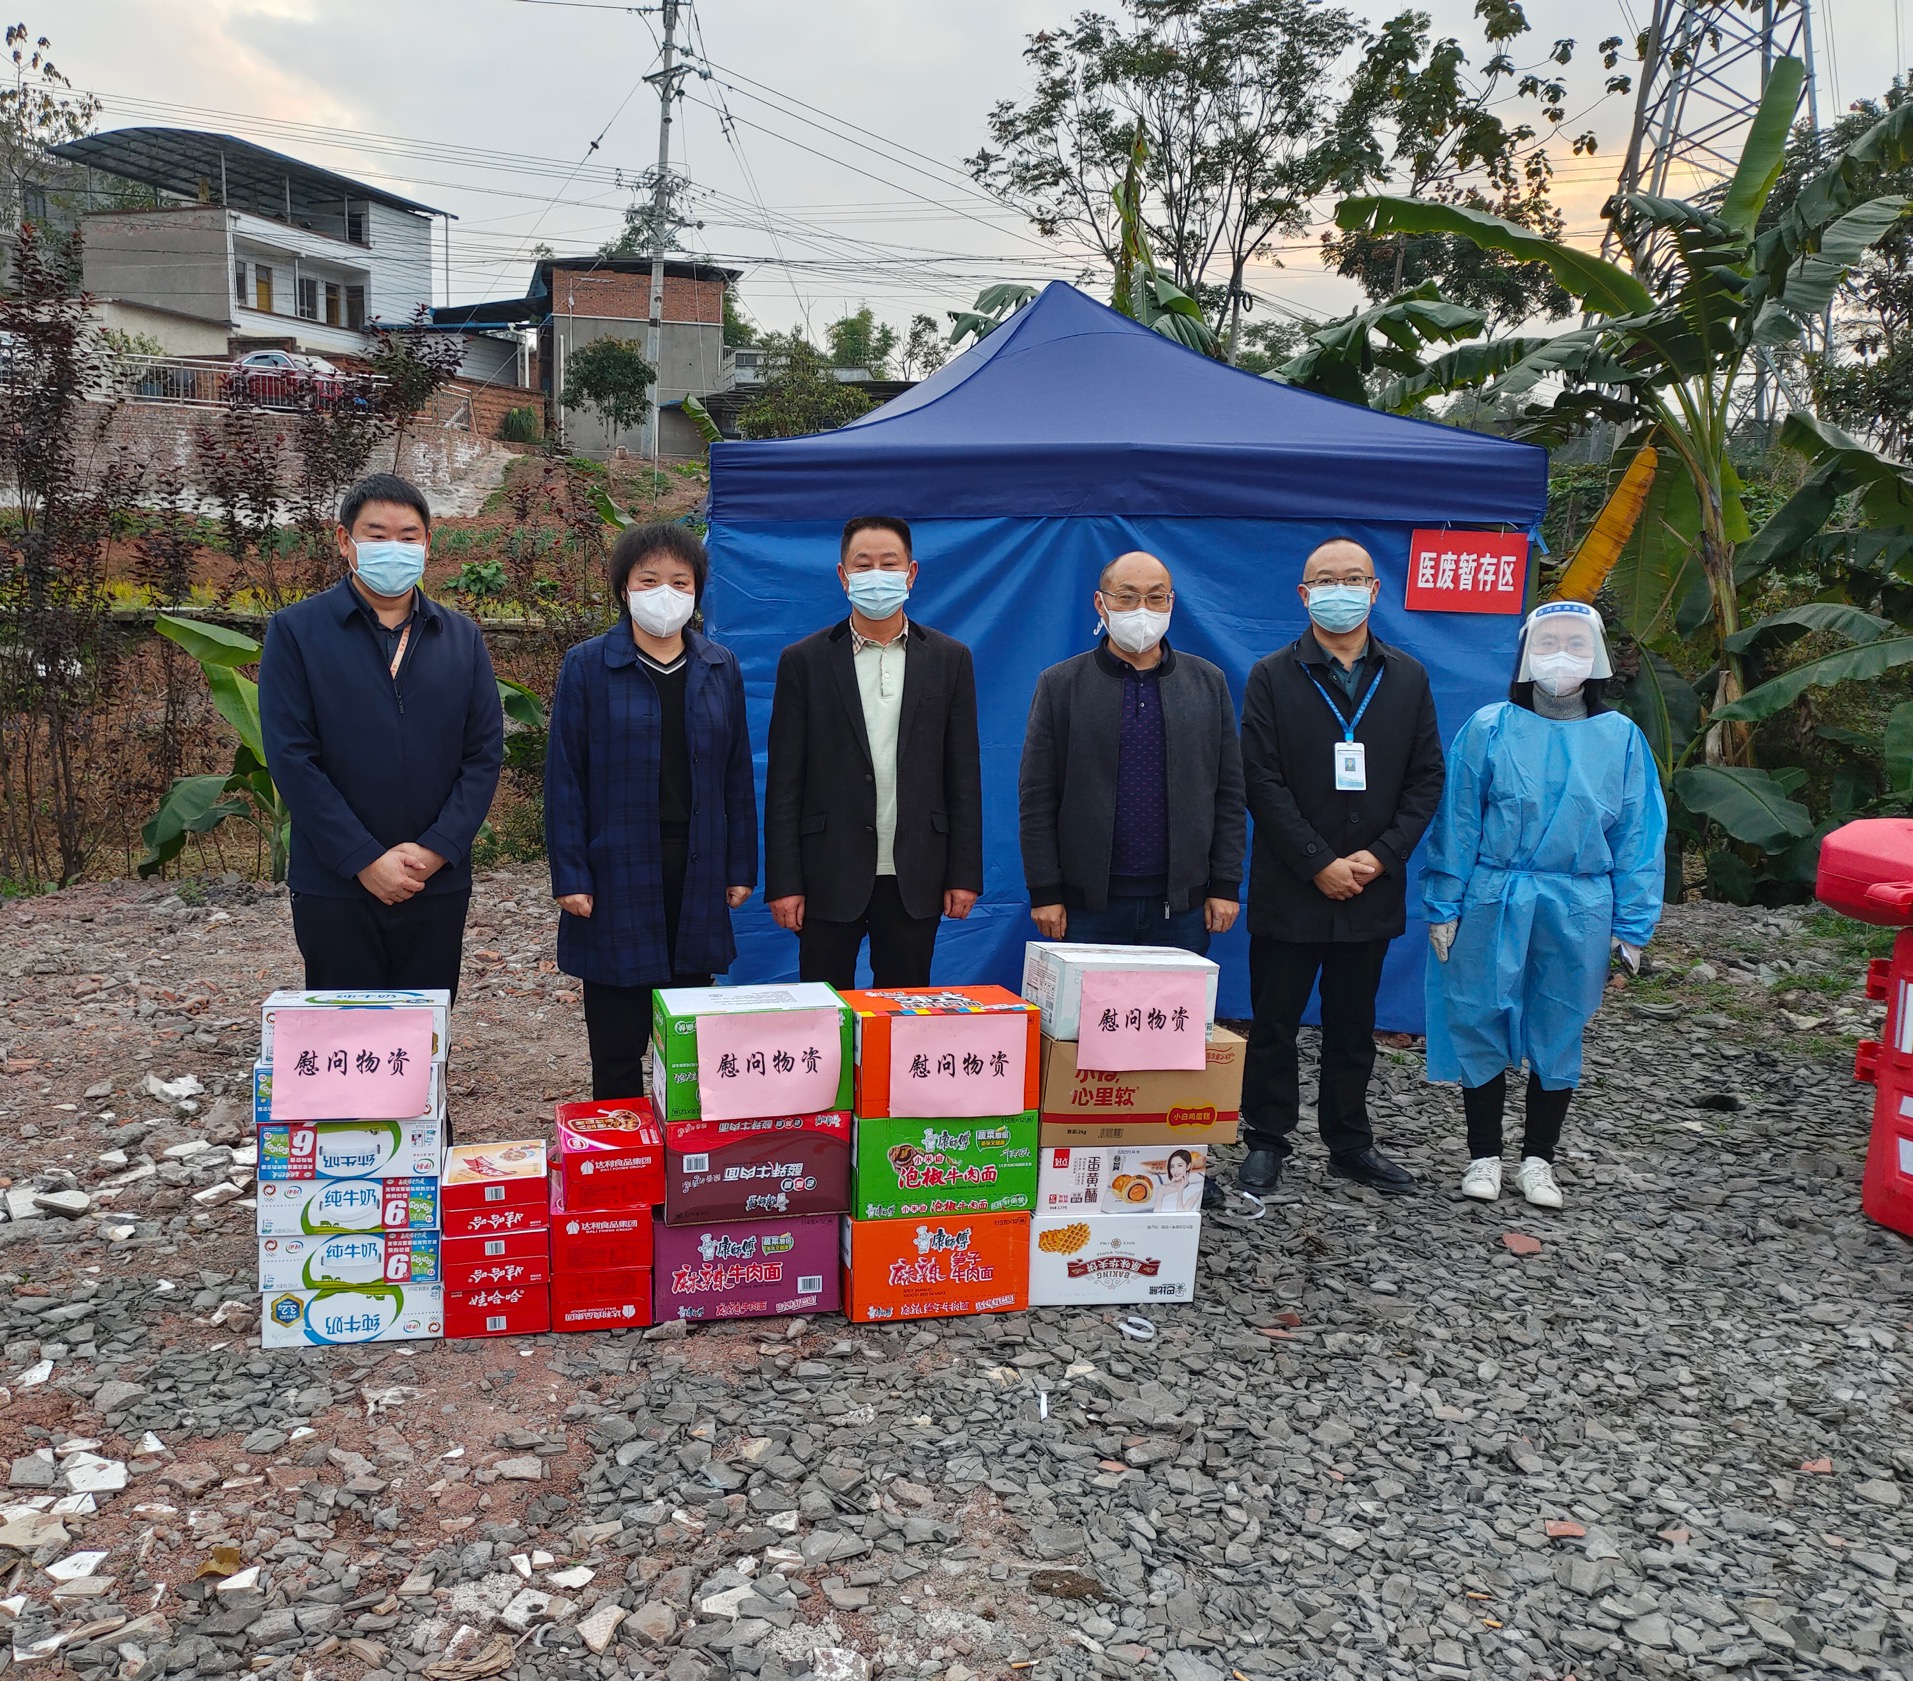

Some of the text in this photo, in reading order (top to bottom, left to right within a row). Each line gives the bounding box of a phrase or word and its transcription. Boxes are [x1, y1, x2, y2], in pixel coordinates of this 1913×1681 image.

[1417, 551, 1517, 592] 医废暂存区
[1098, 1006, 1190, 1032] 慰问物资
[294, 1048, 410, 1076] 慰问物资
[717, 1046, 822, 1078] 慰问物资
[908, 1051, 1009, 1078] 慰问物资
[1071, 1086, 1136, 1106] 心里软
[1173, 1111, 1211, 1121] 小白鸡蛋糕
[937, 1130, 971, 1150] 康师傅
[595, 1156, 652, 1169] 达利食品集团
[723, 1161, 804, 1182] 酸辣牛肉面
[898, 1164, 998, 1190] 泡椒牛肉面
[1084, 1156, 1101, 1203] 蛋黄酥
[324, 1188, 377, 1207] 纯牛奶
[930, 1199, 989, 1213] 泡椒牛肉面
[581, 1219, 638, 1230] 达利食品集团
[717, 1235, 757, 1260] 康师傅
[931, 1227, 973, 1250] 康师傅
[326, 1242, 378, 1259] 纯牛奶
[951, 1251, 982, 1268] 笋子
[888, 1257, 994, 1286] 麻辣 牛肉面
[1087, 1258, 1143, 1273] 原味华夫饼
[1097, 1270, 1130, 1279] BAKING
[671, 1261, 784, 1294] 麻辣牛肉面
[1149, 1284, 1175, 1295] 巴比熊
[277, 1304, 297, 1315] 3.2g
[565, 1309, 621, 1322] 达利食品集团
[715, 1300, 768, 1317] 麻辣牛肉面
[325, 1313, 381, 1335] 纯牛奶
